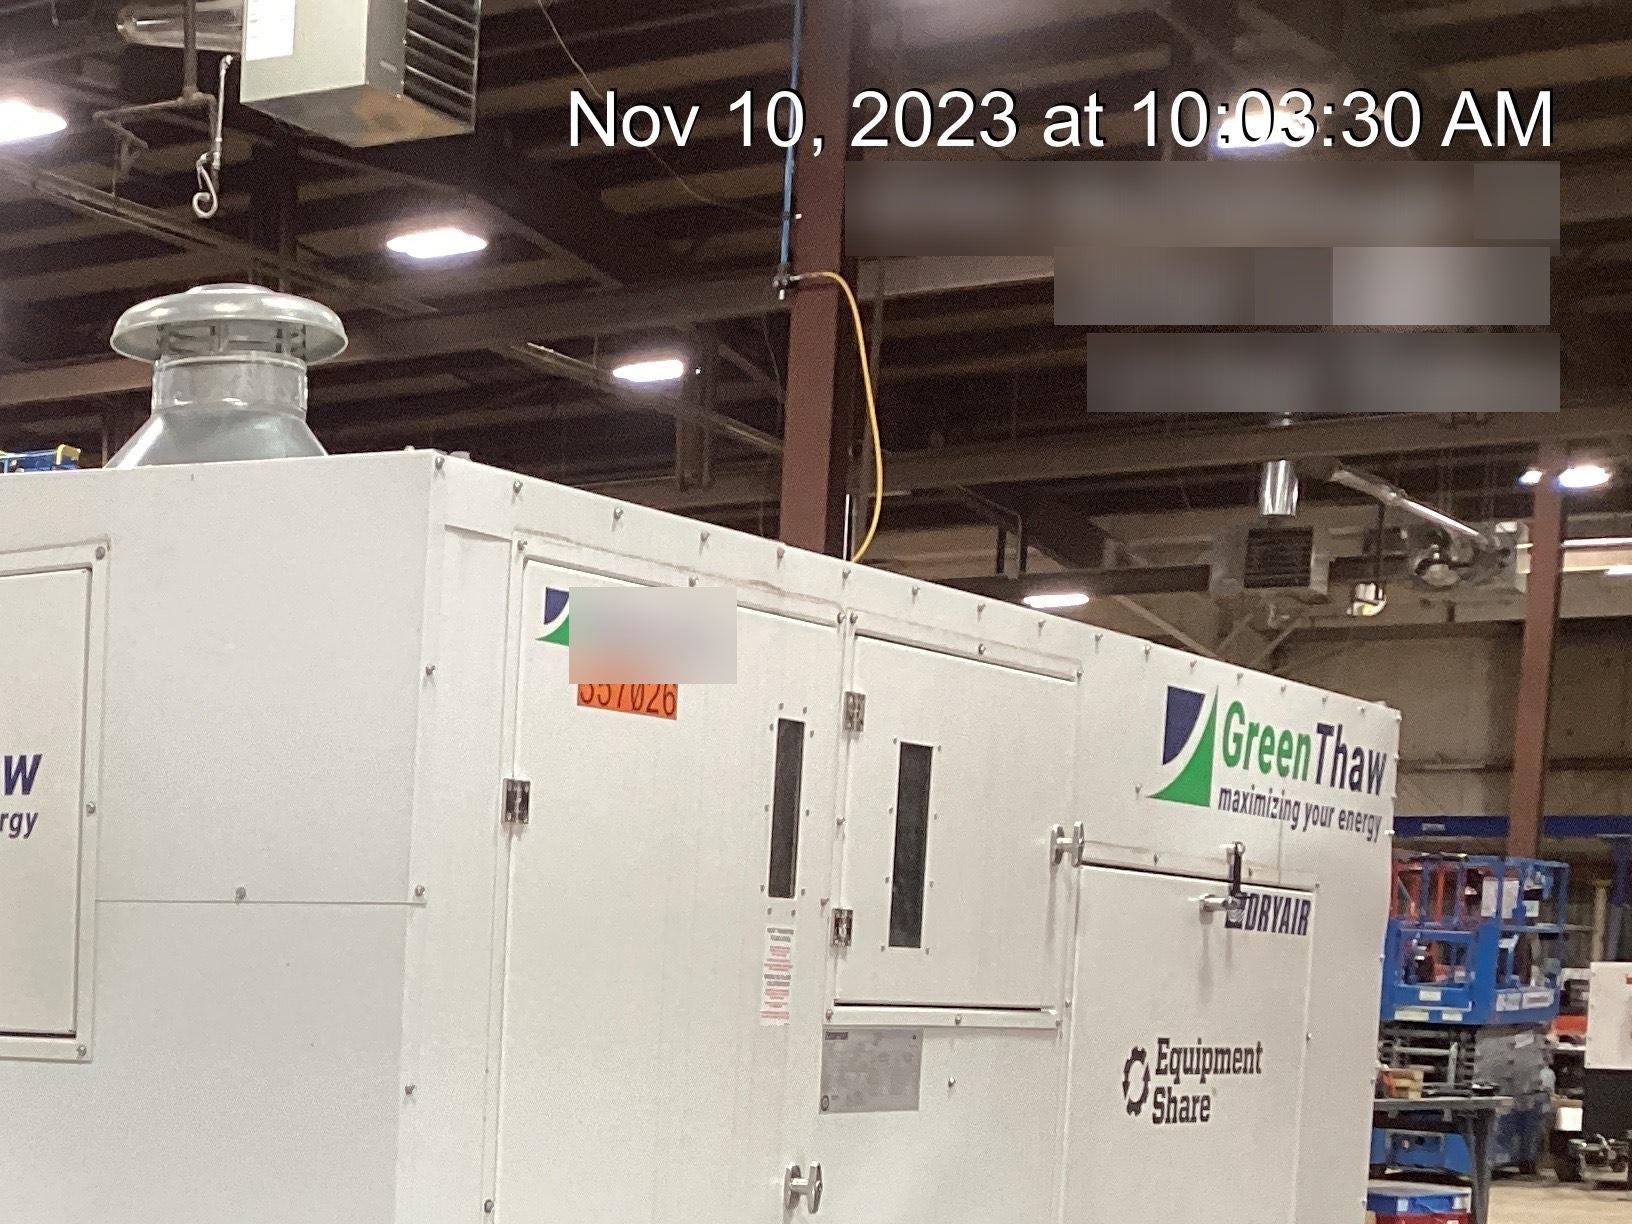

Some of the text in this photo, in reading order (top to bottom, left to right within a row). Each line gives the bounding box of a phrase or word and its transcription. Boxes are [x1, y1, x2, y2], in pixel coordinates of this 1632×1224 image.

[1218, 785, 1382, 843] maximizing your energy
[1245, 893, 1311, 936] DRYAIR
[1155, 1037, 1263, 1084] Equipment
[1152, 1086, 1210, 1125] Share
